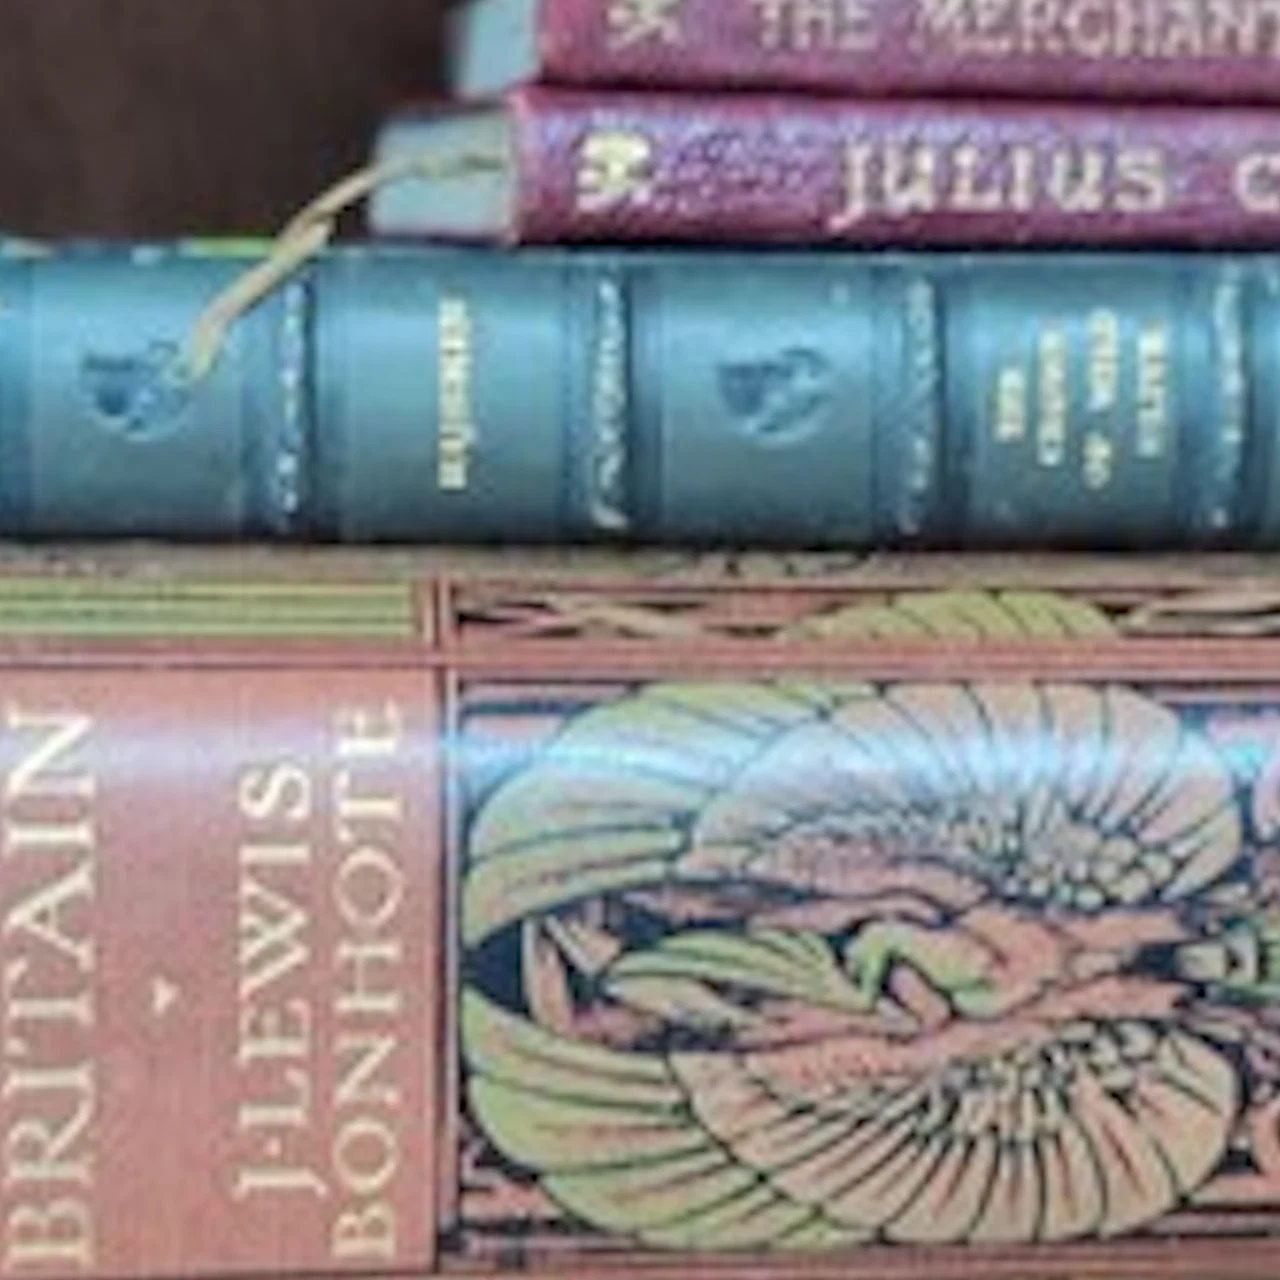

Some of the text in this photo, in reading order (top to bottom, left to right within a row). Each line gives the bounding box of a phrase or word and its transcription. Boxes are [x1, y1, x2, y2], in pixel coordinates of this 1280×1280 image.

[826, 140, 1170, 233] JULIUS
[1, 701, 97, 1273] BRITAIN
[331, 698, 407, 1262] BONHOTE
